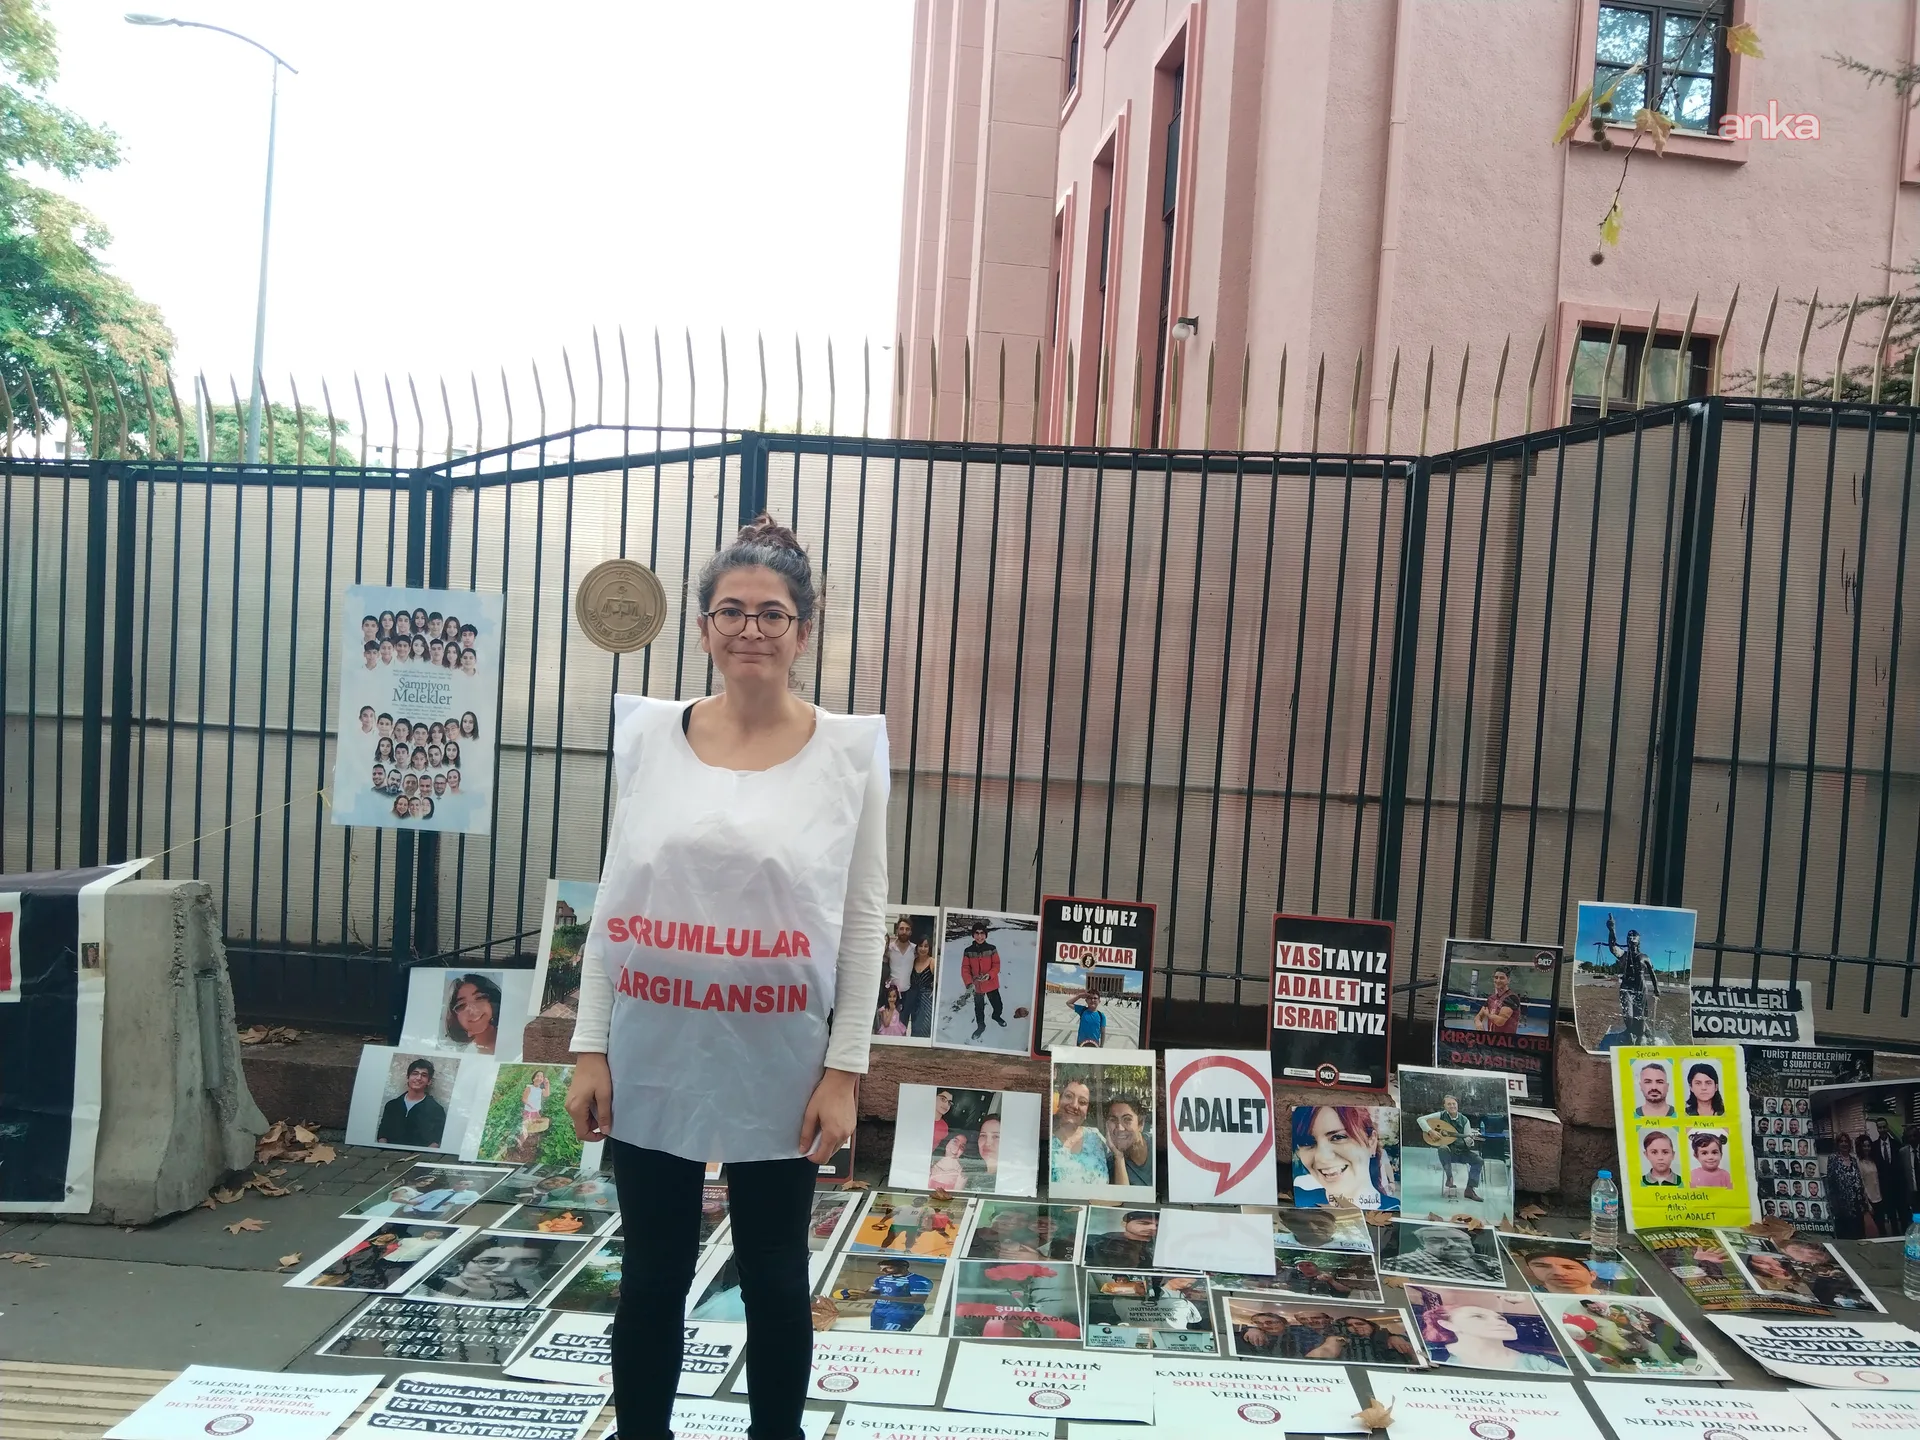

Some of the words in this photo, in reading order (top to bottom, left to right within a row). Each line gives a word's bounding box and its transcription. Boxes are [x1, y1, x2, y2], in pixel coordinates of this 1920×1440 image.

[398, 676, 451, 693] Şampiyon
[392, 688, 452, 705] Melekler
[1061, 904, 1138, 927] BÜYÜMEZ
[1082, 925, 1113, 945] ÖLÜ
[1279, 944, 1387, 974] YASTAYIZ
[615, 966, 808, 1013] ARGILANSIN
[1277, 975, 1386, 1005] ADALETTE
[1691, 988, 1788, 1009] KATİLLERİ
[1276, 1005, 1386, 1036] ISRARLIYIZ
[1693, 1015, 1792, 1037] KORUMA!
[1762, 1049, 1790, 1060] TURİST
[1791, 1051, 1852, 1062] REHBERLERİMİZ
[1789, 1061, 1811, 1069] ŞUBAT
[1812, 1061, 1831, 1069] 04:17
[1179, 1097, 1266, 1133] ADALET
[1685, 1212, 1716, 1220] ADALET
[1652, 1238, 1719, 1250] ADALET
[1773, 1327, 1852, 1338] HUKUK
[554, 1335, 612, 1349] SUÇL
[683, 1344, 725, 1357] EĞİL
[838, 1344, 924, 1356] FELAKETİ
[1744, 1335, 1848, 1351] SUÇLUYU
[1850, 1340, 1916, 1352] DEĞİL
[533, 1349, 613, 1364] MAĞDU
[681, 1362, 728, 1374] RUR
[816, 1353, 876, 1364] DEĞİL,
[1001, 1358, 1102, 1371] KATLİAMIN
[1755, 1350, 1867, 1366] MAĞDURU
[1868, 1356, 1920, 1367] KOR
[828, 1364, 921, 1377] KATLİAMI!
[1013, 1369, 1037, 1378] İYİ
[1044, 1372, 1087, 1381] HALİ
[1155, 1370, 1205, 1379] KAMU
[1209, 1372, 1346, 1385] GÖREVLİLERİNE
[209, 1388, 252, 1397] HESAP
[254, 1383, 291, 1391] BUNU
[294, 1385, 358, 1394] YAPANLAR
[1016, 1380, 1087, 1391] OLMAZ!
[1172, 1380, 1291, 1392] SORUŞTURMA
[1295, 1384, 1332, 1393] İZNİ
[1402, 1385, 1436, 1394] ADLİ
[1440, 1388, 1494, 1397] YILINIZ
[1498, 1391, 1548, 1399] KUTLU
[401, 1382, 501, 1400] TUTUKLAMA
[503, 1391, 566, 1405] KİMLER
[1211, 1390, 1298, 1402] VERİLSİN!
[1450, 1396, 1507, 1406] OLSUN!
[1645, 1396, 1656, 1405] 6
[1661, 1398, 1754, 1410] ŞUBAT'IN
[244, 1405, 331, 1417] BİLMİYORUM
[391, 1398, 467, 1416] İSTİSNA,
[471, 1407, 545, 1421] KİMLER
[546, 1409, 582, 1423] İÇİN
[1405, 1402, 1464, 1411] ADALET
[1511, 1408, 1562, 1417] ENKAZ
[1656, 1407, 1760, 1420] KATİLLERİ
[1455, 1412, 1520, 1423] ALTINDA
[372, 1415, 428, 1430] CEZA
[434, 1420, 577, 1440] YÖNTEMİDİR?
[684, 1421, 748, 1434] DENİLD
[861, 1420, 941, 1433] ŞUBAT'IN
[947, 1425, 1050, 1438] ÜZERİNDEN
[1625, 1417, 1695, 1428] NEDEN
[1700, 1420, 1808, 1434] DIŞARIDA?
